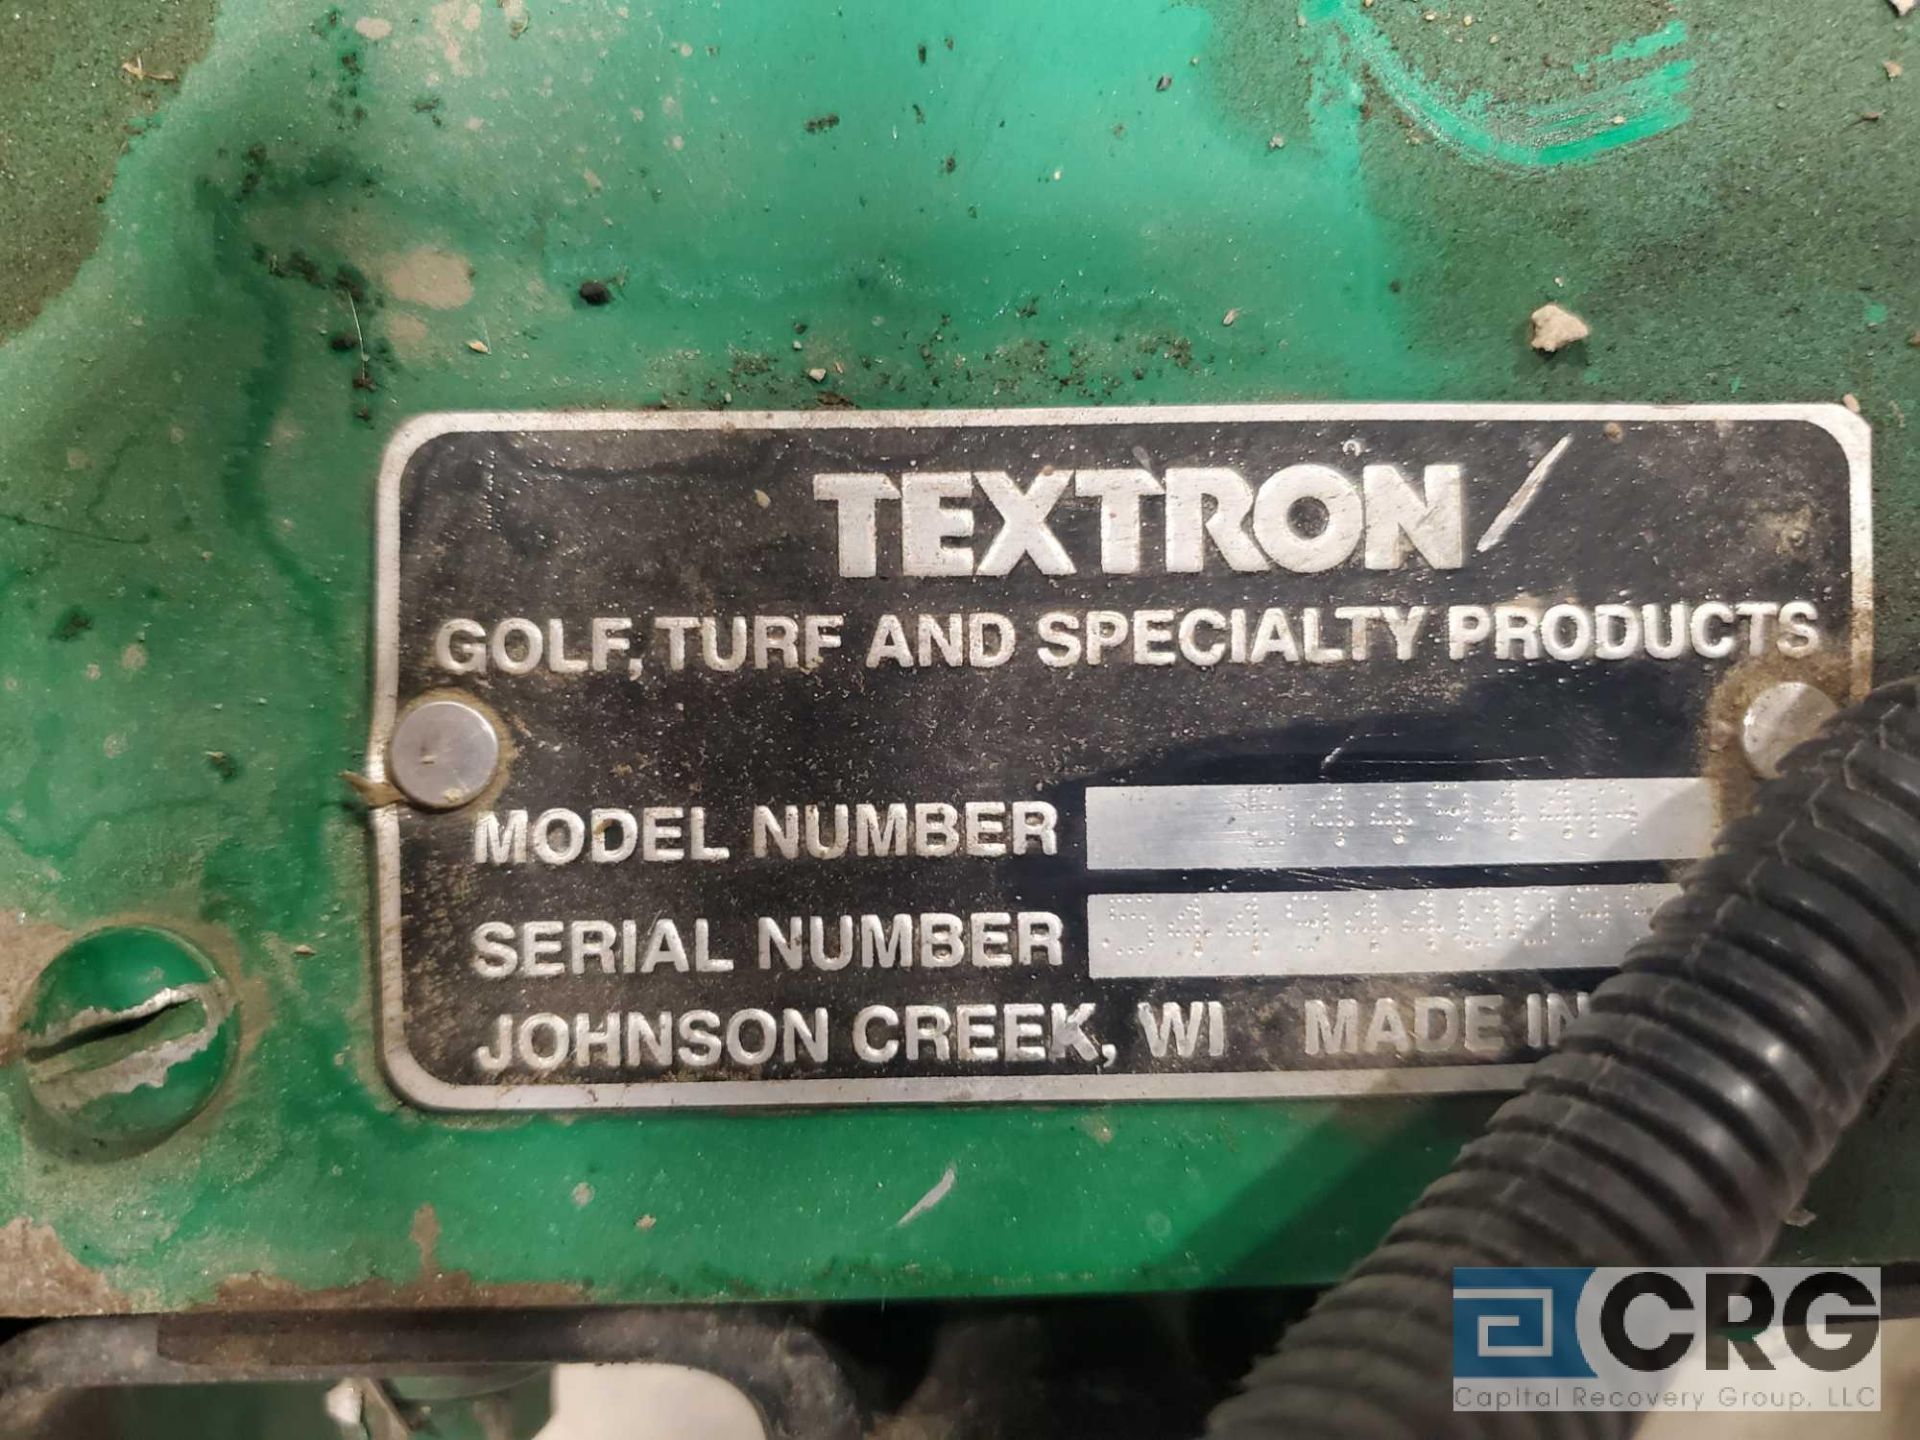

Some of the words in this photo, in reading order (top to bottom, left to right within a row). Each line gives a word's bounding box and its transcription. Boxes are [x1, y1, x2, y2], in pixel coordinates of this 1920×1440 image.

[813, 463, 1465, 580] TEXTRON
[434, 616, 646, 681] GOLF,
[654, 614, 845, 675] TURF
[865, 611, 1018, 669] AND
[1037, 604, 1430, 668] SPECIALTY
[1449, 601, 1820, 661] PRODUCTS
[473, 806, 731, 867] MODEL
[752, 800, 1060, 860] NUMBER
[470, 917, 735, 979] SERIAL
[757, 911, 1065, 972] NUMBER
[472, 1007, 829, 1071] JOHNSON
[852, 1002, 1117, 1069] CREEK,
[1137, 1000, 1226, 1058] WI
[1303, 994, 1504, 1056] MADE
